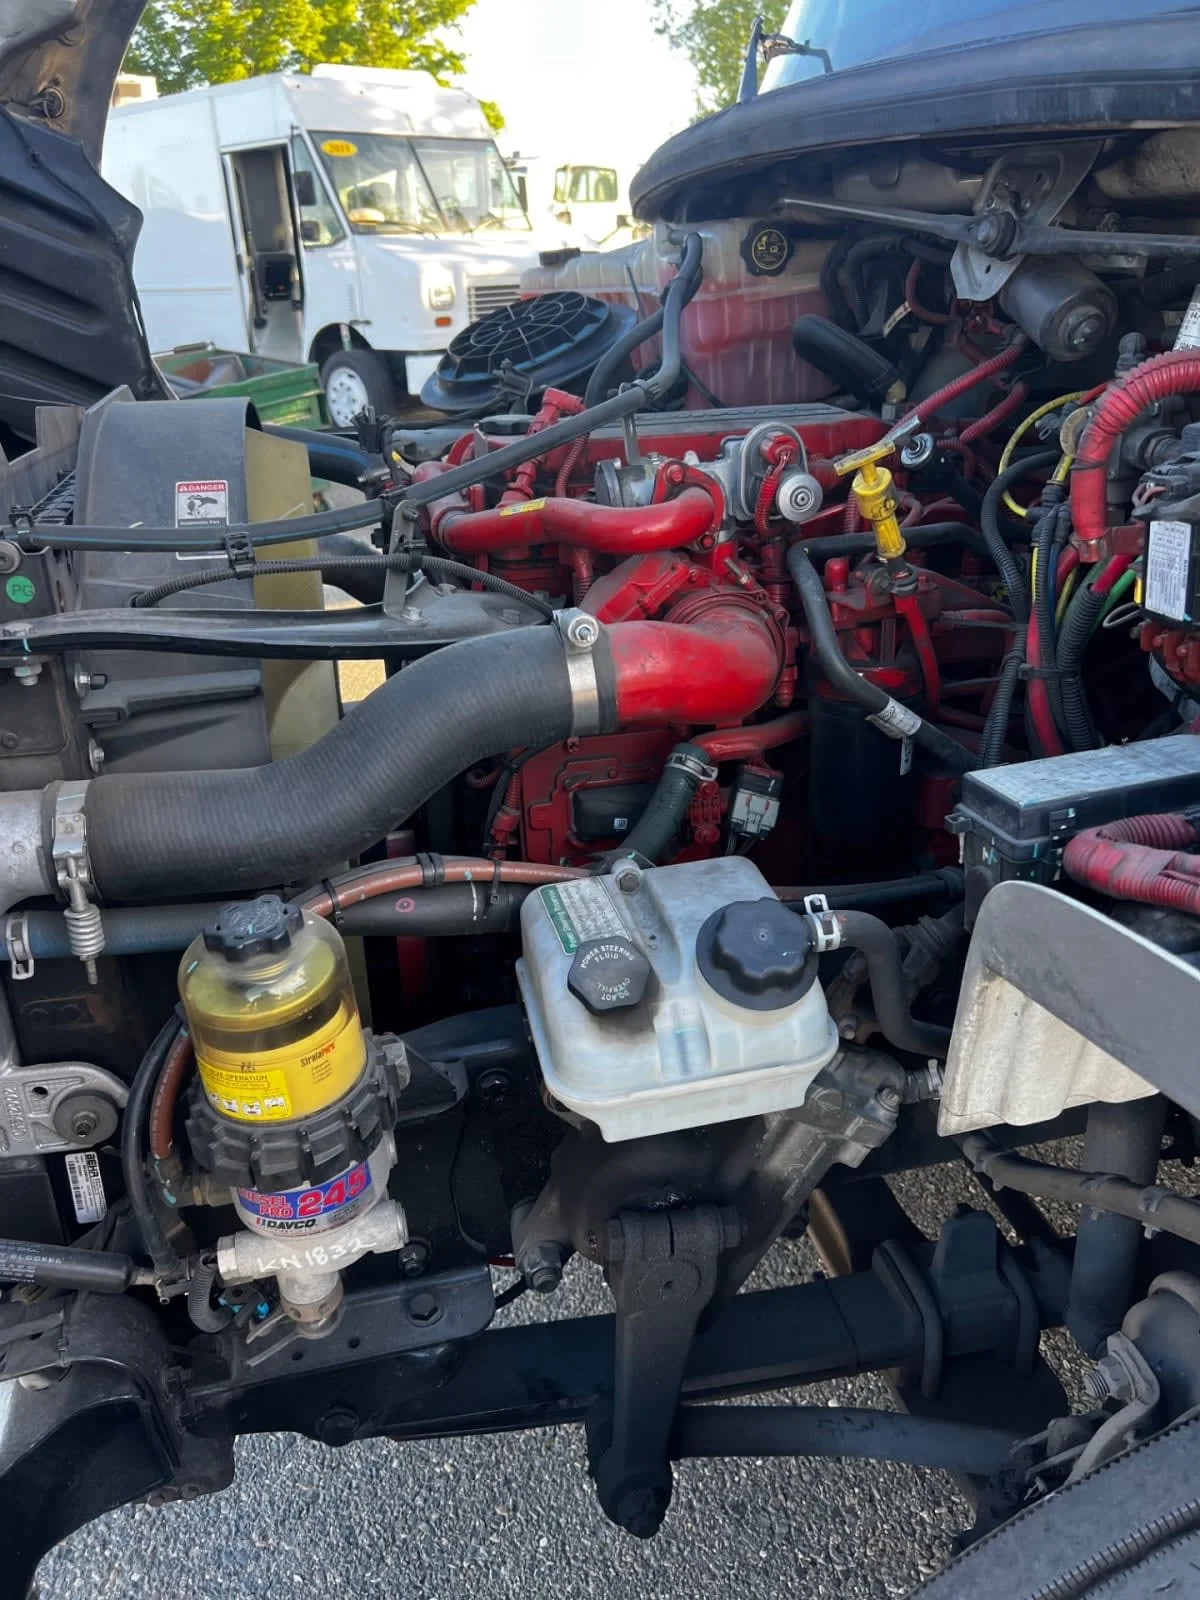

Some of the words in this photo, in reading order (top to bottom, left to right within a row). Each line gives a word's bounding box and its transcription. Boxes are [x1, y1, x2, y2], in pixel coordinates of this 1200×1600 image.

[188, 484, 225, 492] DANGER
[580, 946, 599, 969] POWER
[600, 944, 636, 961] STEERING
[594, 952, 619, 963] FLUID
[601, 992, 617, 1001] NOT
[85, 1153, 99, 1178] BEHR
[260, 1204, 293, 1218] PRO
[297, 1161, 367, 1217] 245
[265, 1218, 316, 1230] DAVCO
